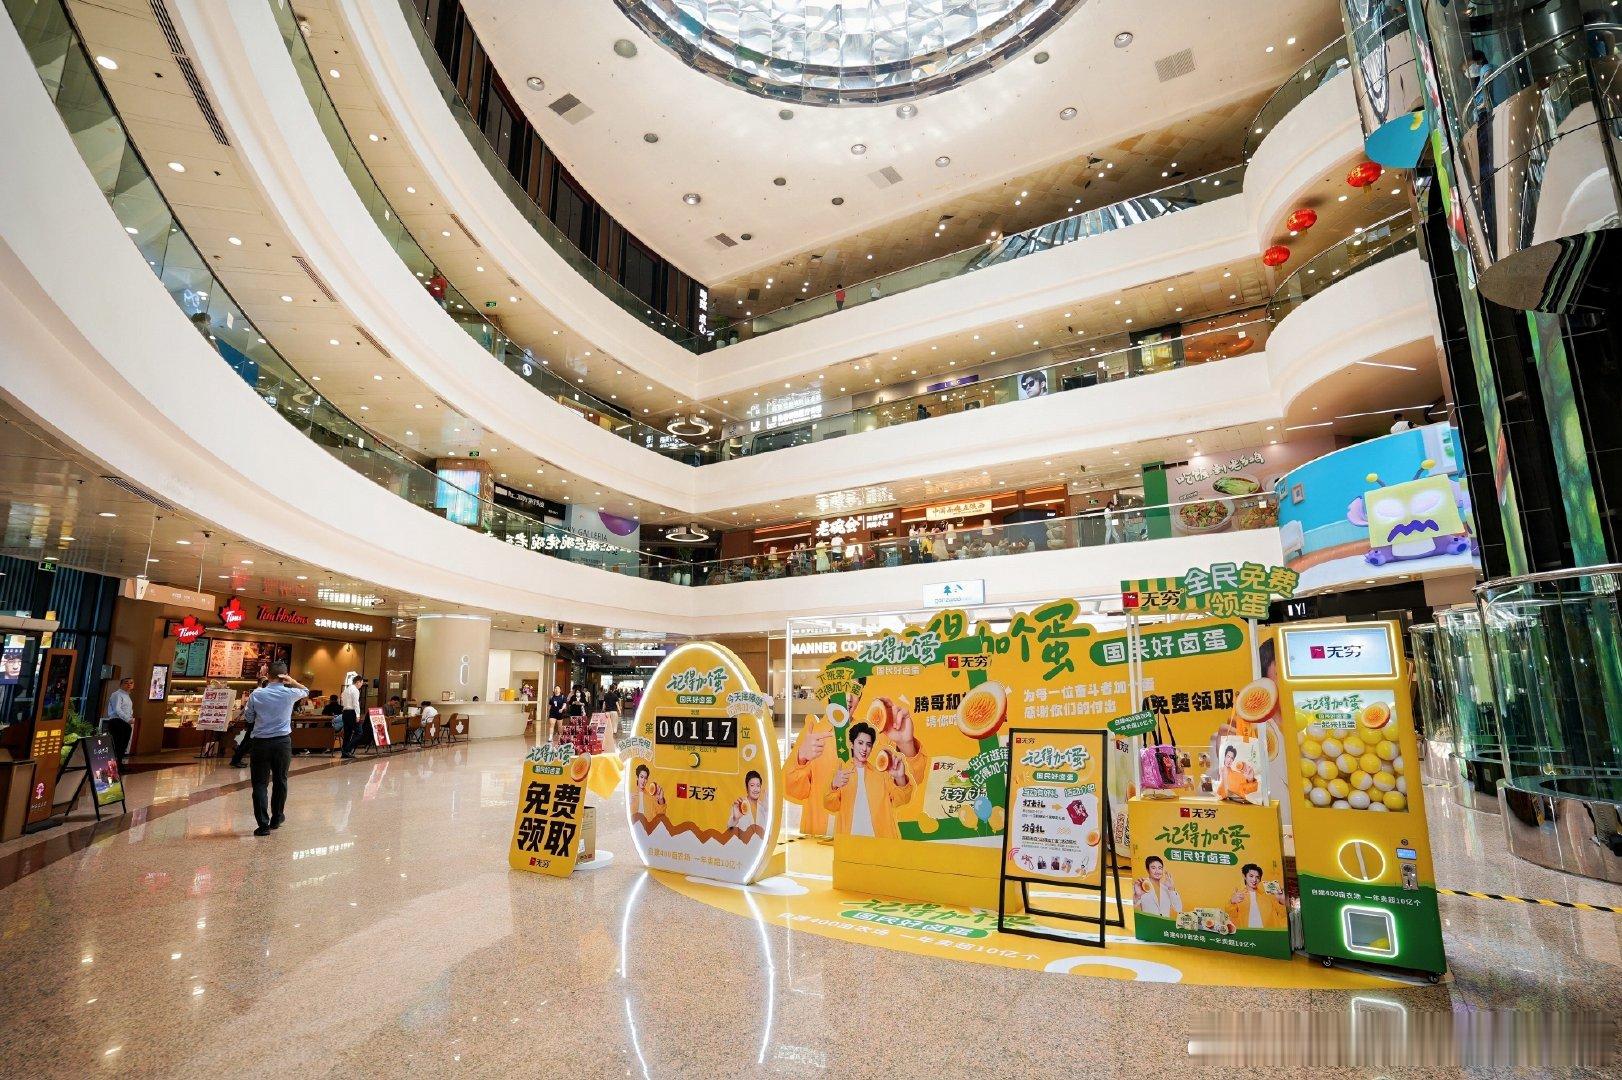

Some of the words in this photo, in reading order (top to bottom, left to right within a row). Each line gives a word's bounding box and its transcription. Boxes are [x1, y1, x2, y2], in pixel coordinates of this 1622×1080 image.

[1184, 562, 1297, 597] 全民免费
[1141, 590, 1180, 606] 无穷
[1210, 591, 1269, 617] 领蛋
[275, 607, 310, 625] Hortons
[179, 627, 199, 637] Tims
[791, 641, 837, 655] MANNER
[858, 632, 940, 664] 记得加个蛋
[1326, 645, 1361, 658] 无穷
[961, 656, 989, 668] 无穷
[667, 667, 728, 693] 记得加个蛋
[815, 681, 861, 701] 记得加个蛋
[1147, 688, 1234, 715] 免费领取
[1301, 694, 1363, 711] 记得加个蛋
[659, 720, 732, 741] 00117
[741, 727, 751, 738] 位
[526, 744, 573, 765] 记得加个蛋
[1021, 747, 1087, 768] 记得加个蛋
[523, 781, 581, 819] 免费
[688, 786, 717, 801] 无穷
[1191, 808, 1216, 819] 无穷
[517, 817, 577, 857] 领取
[1154, 823, 1250, 852] 记得加个蛋
[536, 859, 551, 868] 无穷
[1170, 849, 1231, 865] 国民好卤蛋
[853, 912, 974, 937] 国民好卤蛋
